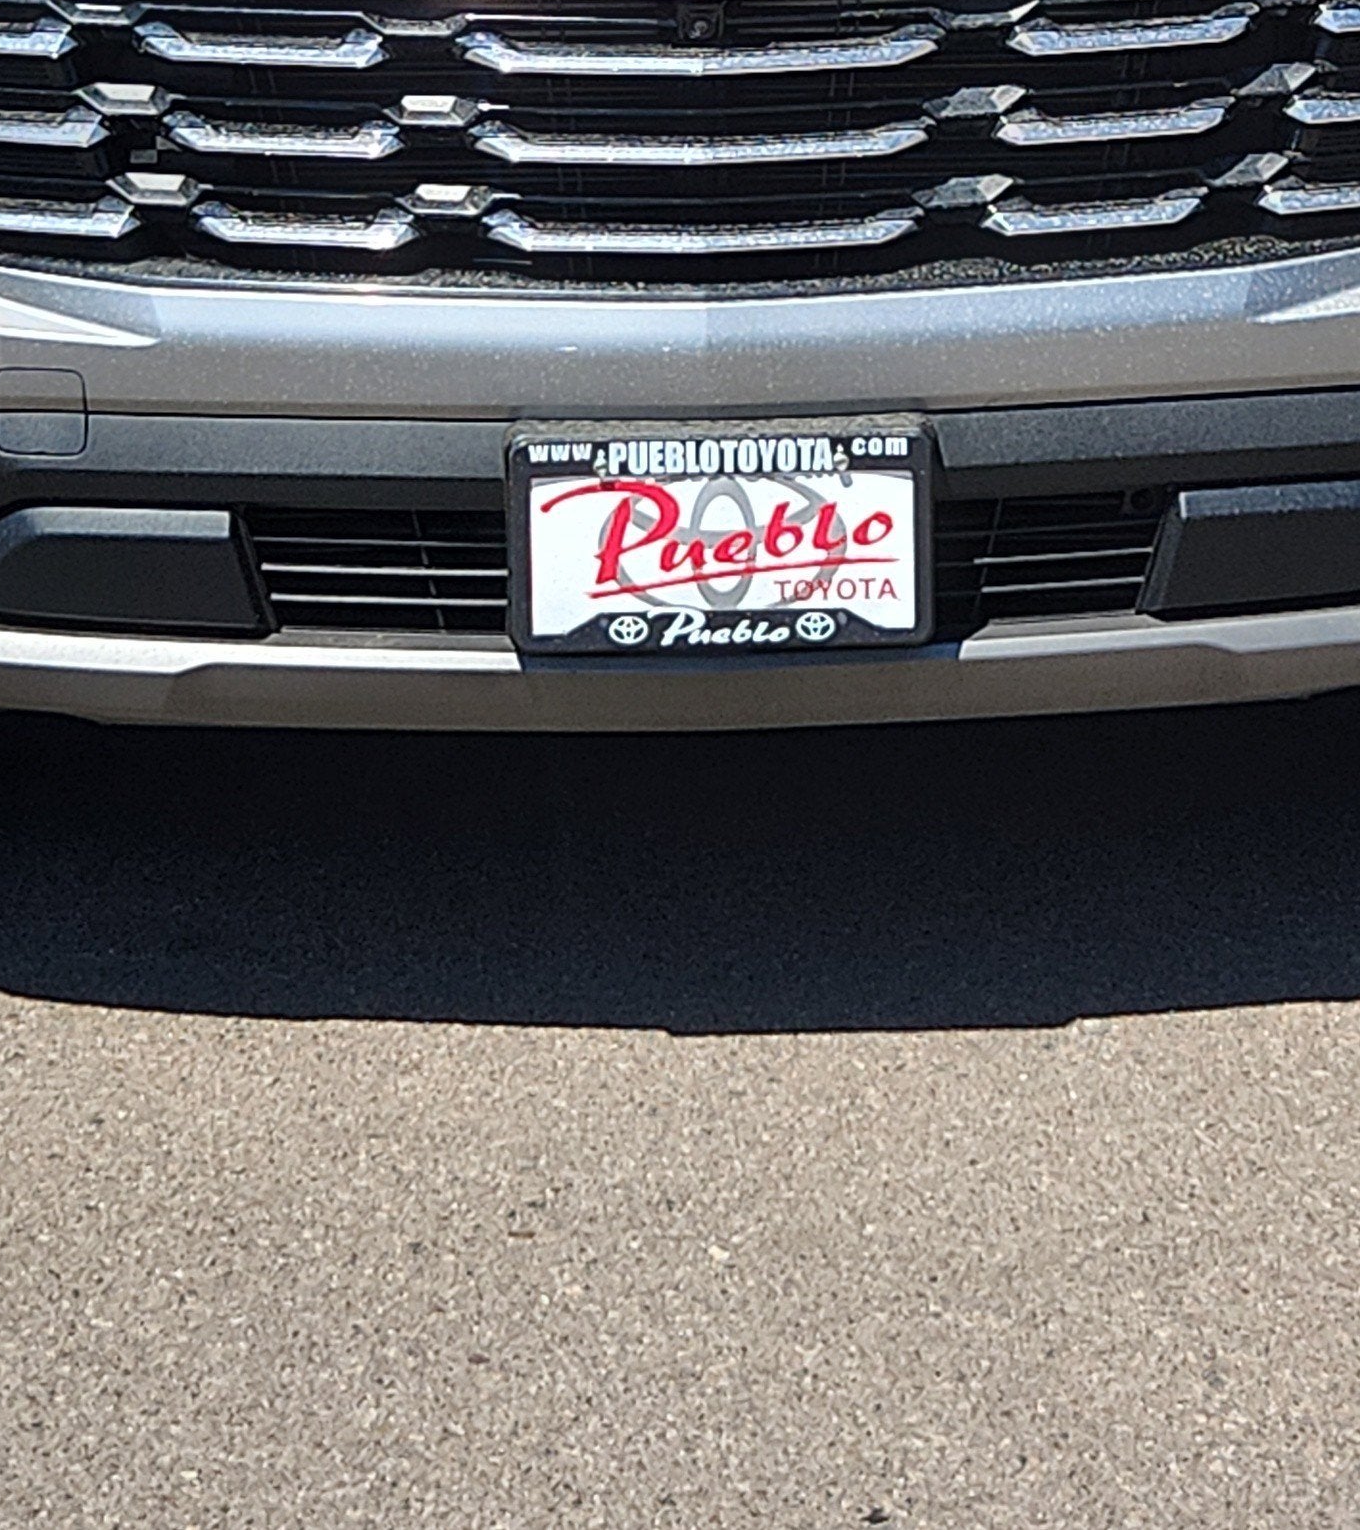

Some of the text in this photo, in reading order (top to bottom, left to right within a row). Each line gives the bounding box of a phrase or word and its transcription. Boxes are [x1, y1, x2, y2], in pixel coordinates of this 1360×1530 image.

[540, 481, 894, 584] Pueblo
[774, 578, 900, 601] TOYOTA
[648, 605, 791, 646] Pueblo
